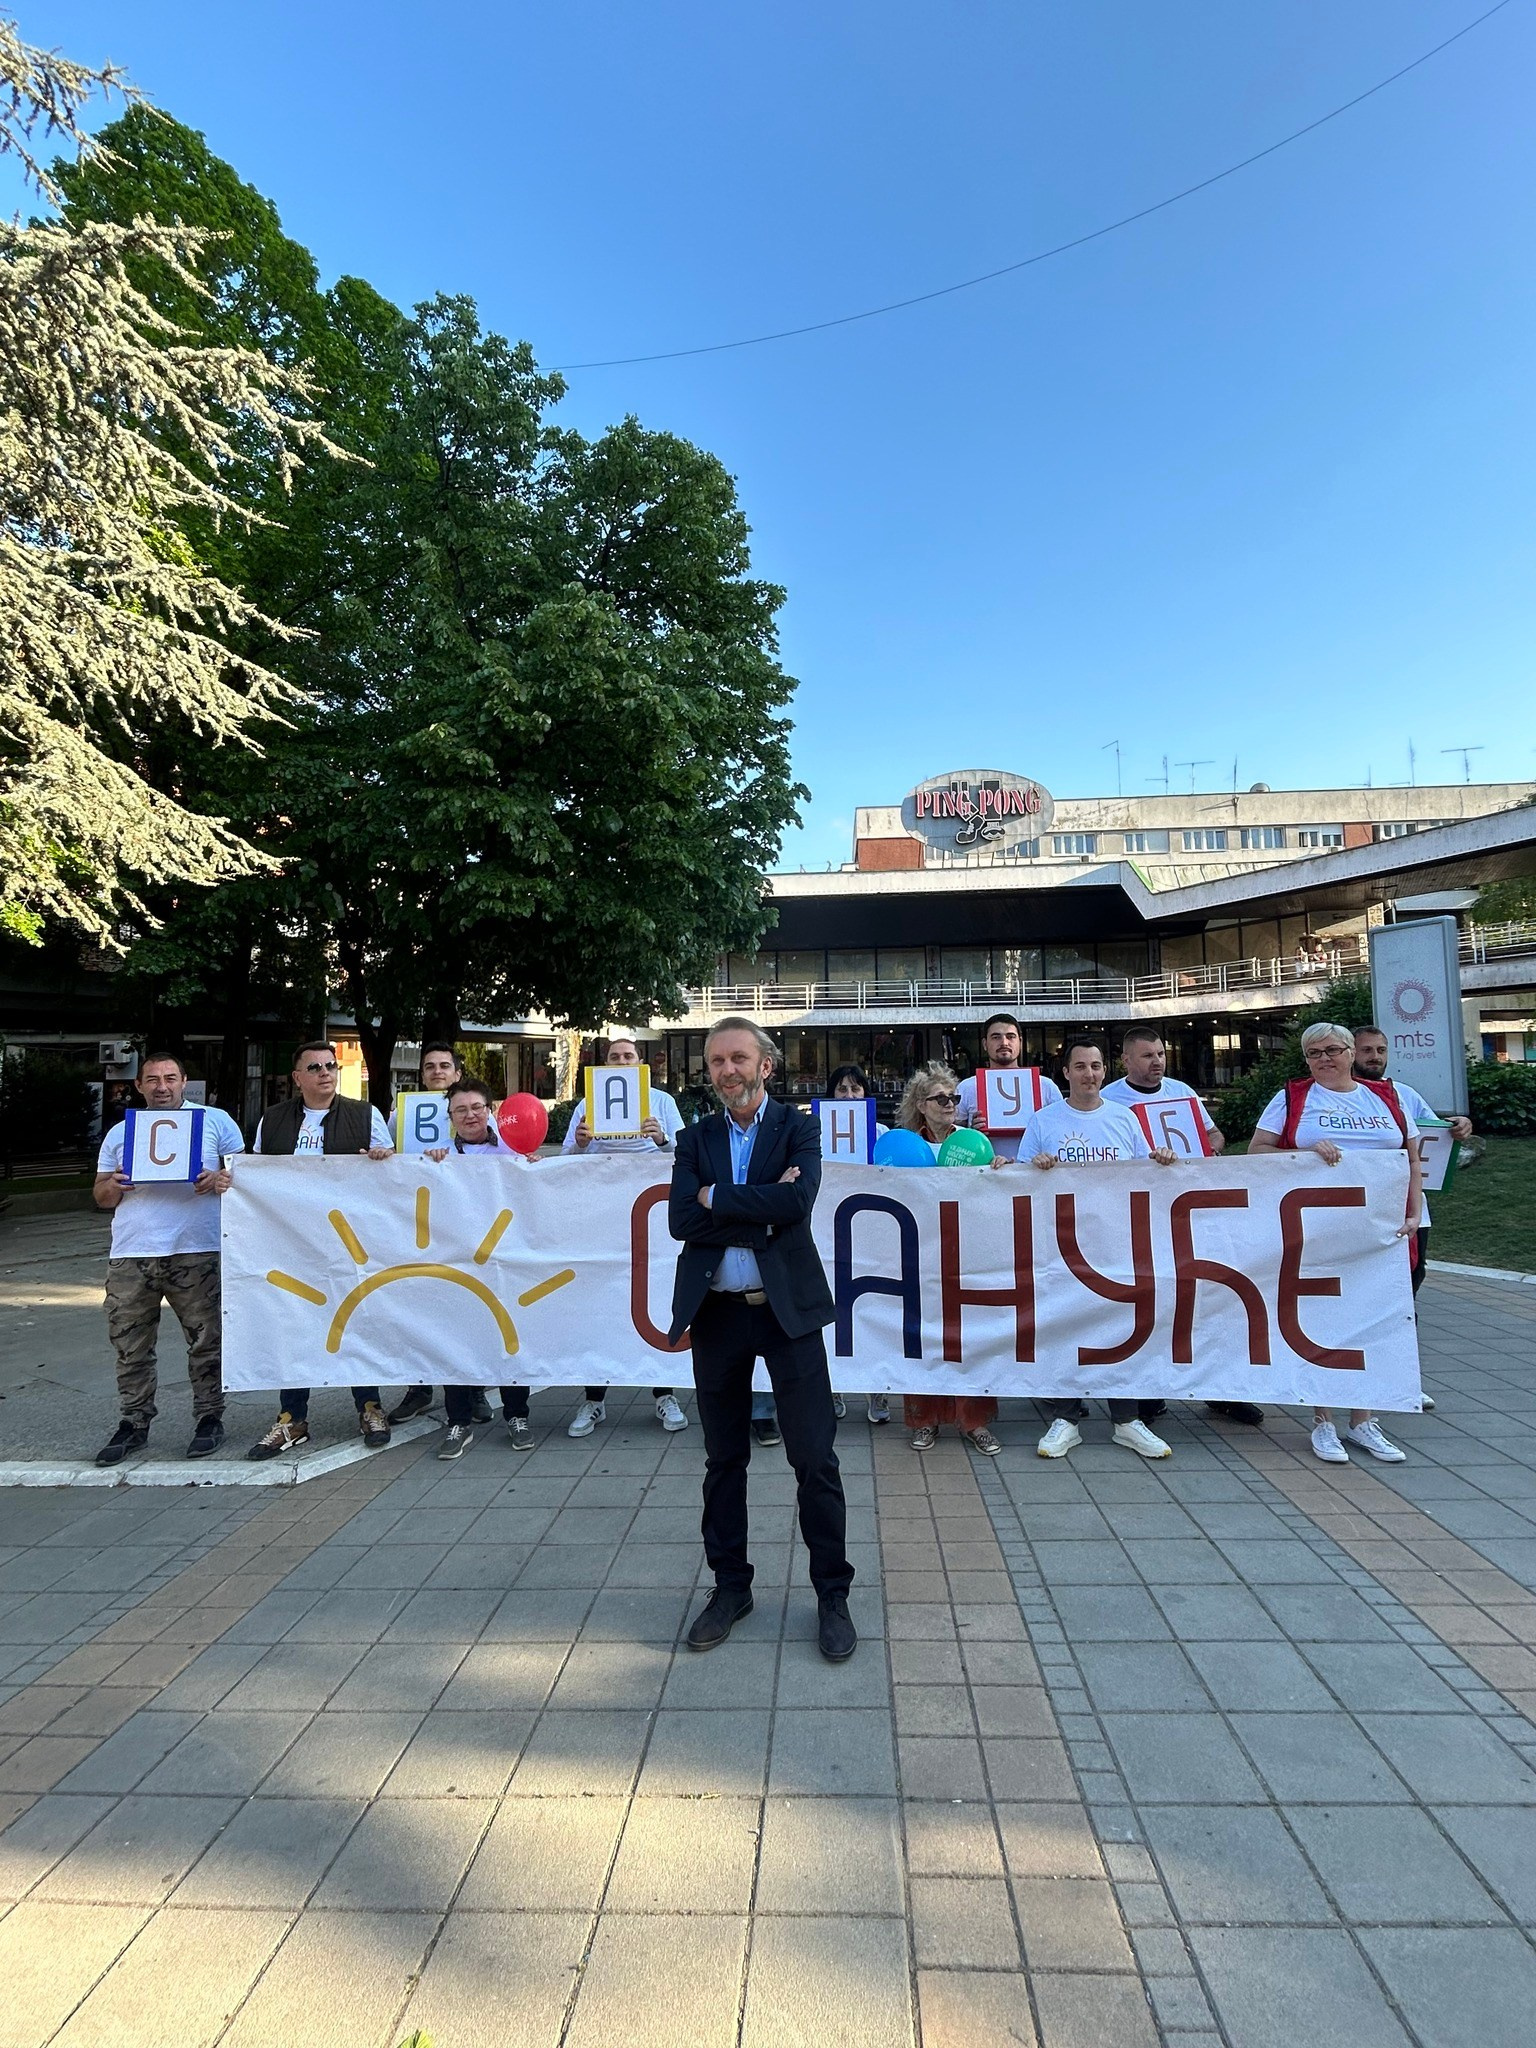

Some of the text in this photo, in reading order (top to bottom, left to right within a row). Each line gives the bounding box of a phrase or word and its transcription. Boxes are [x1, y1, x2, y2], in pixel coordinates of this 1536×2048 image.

[917, 787, 1041, 817] PING PONG
[1394, 1031, 1435, 1048] mts
[1416, 1051, 1437, 1060] svet
[605, 1076, 628, 1119] А
[415, 1103, 439, 1143] В
[831, 1109, 855, 1154] Н
[1319, 1115, 1394, 1130] СВАНУЋЕ
[631, 1183, 1366, 1371] САНУЋЕ
